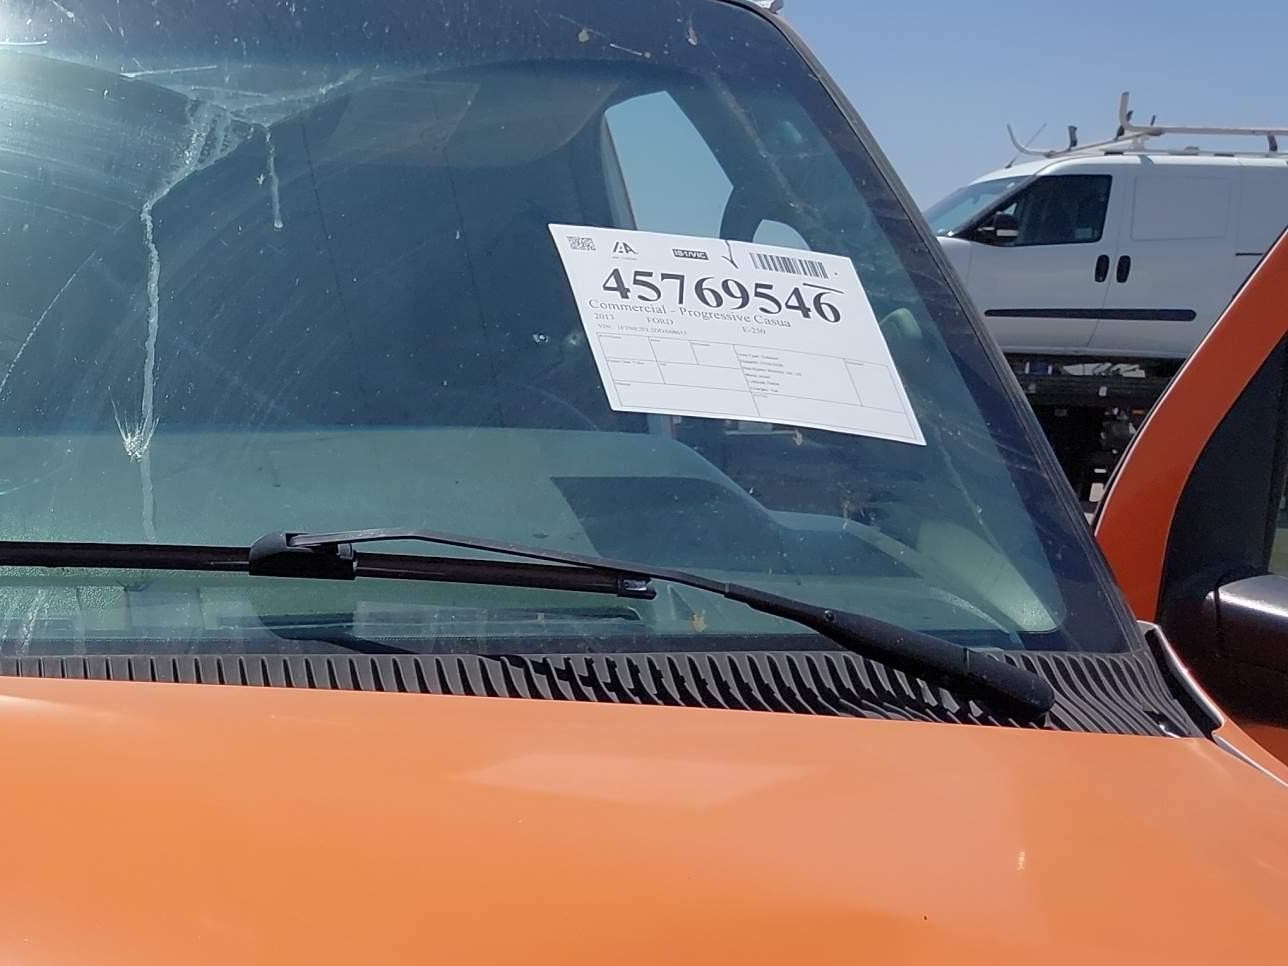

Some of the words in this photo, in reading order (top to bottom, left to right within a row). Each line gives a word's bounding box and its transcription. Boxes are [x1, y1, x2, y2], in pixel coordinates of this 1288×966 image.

[602, 267, 845, 324] 45769546
[589, 298, 667, 315] Commercial
[679, 304, 751, 327] Progressive
[753, 312, 791, 328] Casua
[646, 315, 674, 326] FORD
